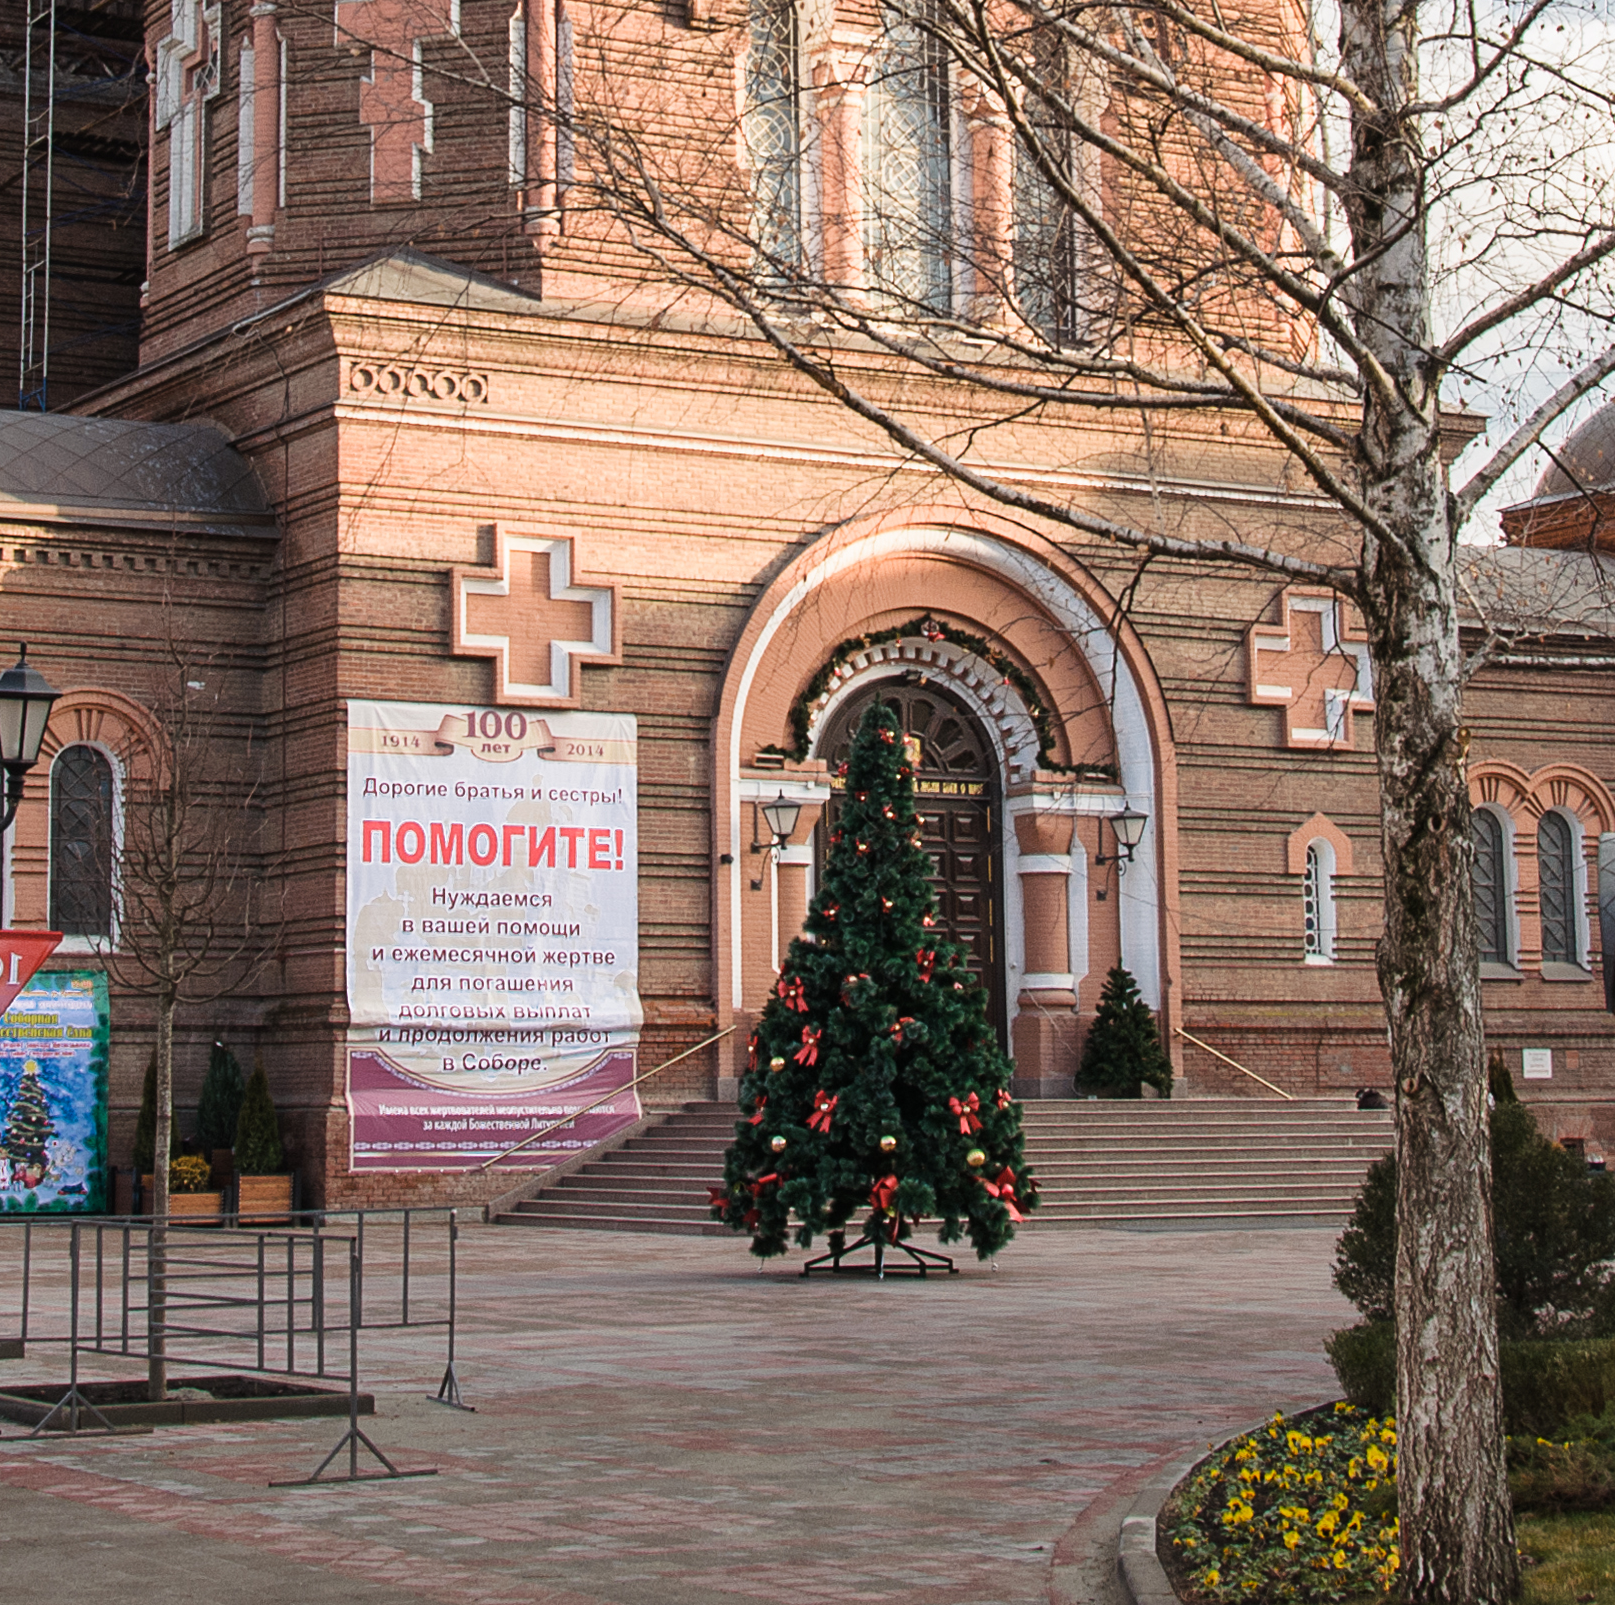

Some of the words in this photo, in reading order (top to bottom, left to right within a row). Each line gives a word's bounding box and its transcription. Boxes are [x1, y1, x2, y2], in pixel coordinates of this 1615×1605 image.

[462, 710, 527, 740] 100
[381, 734, 421, 749] 1914
[480, 742, 511, 755] лет
[567, 743, 604, 757] 2014
[363, 777, 448, 799] Дорогие
[455, 781, 524, 802] братья
[531, 788, 542, 800] и
[549, 787, 623, 806] сестры!
[362, 819, 624, 871] ПОМОГИТЕ!
[432, 887, 552, 910] Нуждаемся
[402, 919, 414, 933] в
[422, 917, 490, 934] вашей
[497, 920, 581, 937] помощи
[372, 948, 384, 961] и
[392, 946, 536, 963] ежемесячной
[543, 949, 616, 968] жертве
[411, 977, 452, 993] для
[459, 977, 573, 992] погашения
[398, 1005, 506, 1020] долговых
[513, 1006, 591, 1019] выплат
[378, 1028, 391, 1043] и
[398, 1028, 544, 1047] продолжения
[551, 1028, 612, 1047] работ
[442, 1057, 455, 1071] в
[462, 1052, 548, 1075] Соборе.
[423, 1120, 433, 1131] за
[434, 1119, 468, 1132] каждой
[469, 1118, 530, 1131] Божественной
